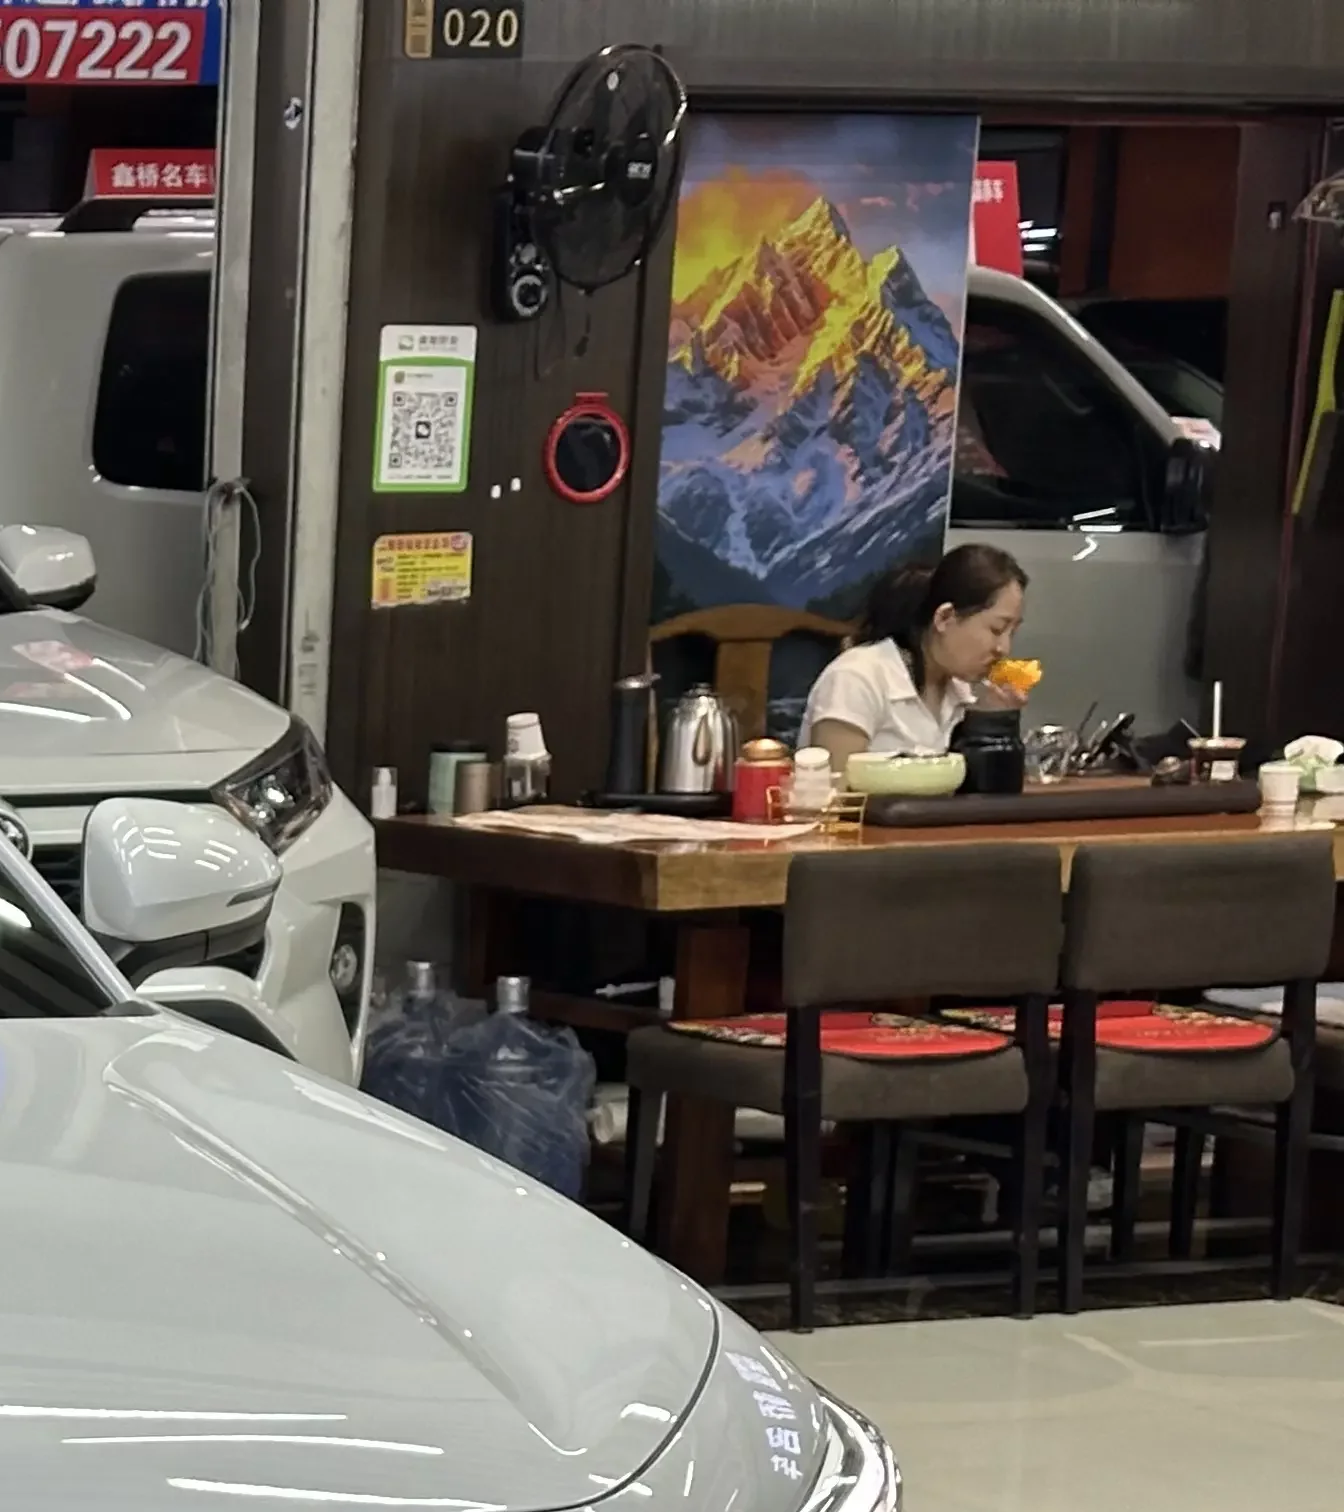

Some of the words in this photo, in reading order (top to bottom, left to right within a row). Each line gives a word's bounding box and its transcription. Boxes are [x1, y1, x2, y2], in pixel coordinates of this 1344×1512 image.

[443, 8, 519, 47] 020
[112, 162, 209, 188] 鑫桥名车
